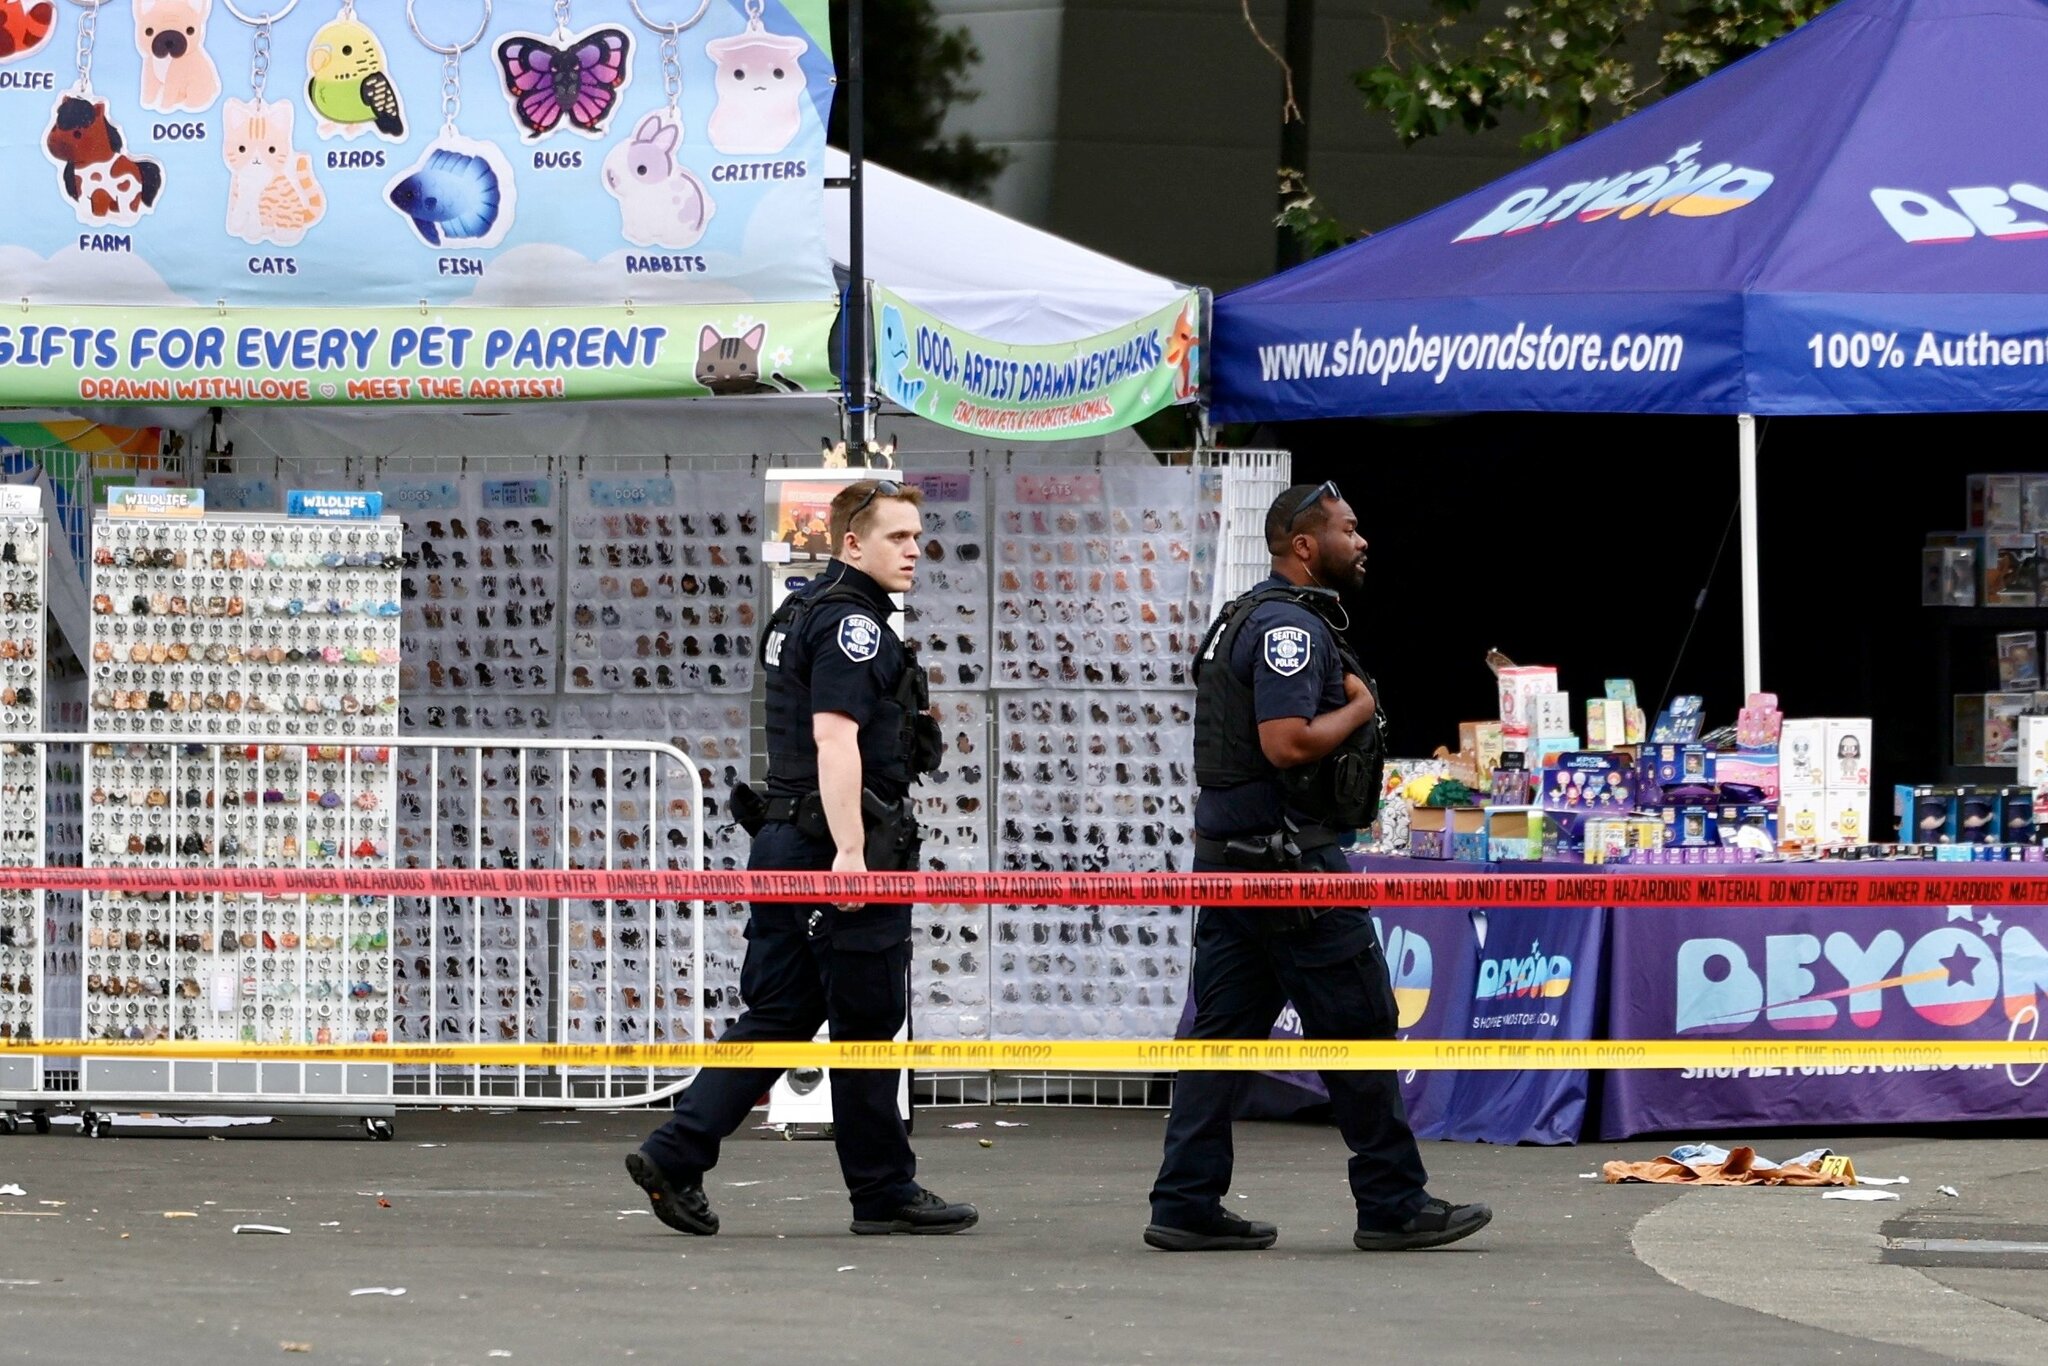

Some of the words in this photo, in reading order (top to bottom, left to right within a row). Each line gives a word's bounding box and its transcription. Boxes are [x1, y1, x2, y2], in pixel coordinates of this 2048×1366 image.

[153, 123, 206, 140] DOGS
[327, 151, 386, 168] BIRDS
[533, 151, 582, 168] BUGS
[712, 161, 807, 182] CRITTERS
[1450, 160, 1774, 244] BEYOND
[79, 234, 131, 252] FARM
[248, 257, 298, 274] CATS
[438, 257, 483, 275] FISH
[626, 256, 706, 274] RABBITS
[130, 326, 225, 369] FOR
[236, 327, 379, 369] EVERY
[391, 326, 472, 368] PET
[485, 327, 666, 368] PARENT
[1259, 322, 1683, 386] www.shopbeyondstore.com
[1808, 332, 1905, 368] 100%
[916, 325, 959, 383] 1000+
[962, 349, 1018, 401] ARTIST
[1019, 362, 1077, 402] DRAWN
[1079, 328, 1162, 394] KEYCHAINS
[81, 379, 171, 401] DRAWN
[175, 379, 246, 400] WITH
[248, 379, 309, 400] LOVE
[347, 378, 411, 400] MEET
[418, 378, 465, 398] THE
[468, 377, 565, 399] ARTIST!
[953, 401, 975, 424] FIND
[976, 406, 999, 429] YOUR
[998, 409, 1018, 430] PETS
[1025, 406, 1071, 430] FAVORITE
[1070, 397, 1113, 423] ANIMALS
[399, 490, 431, 501] DOGS
[615, 488, 646, 499] DOGS
[1041, 483, 1072, 496] CATS
[125, 493, 187, 506] WILDLIFE
[303, 496, 366, 508] WILDLIFE
[847, 618, 876, 634] SEATTLE
[1272, 631, 1303, 642] SEATTLE
[846, 643, 869, 656] POLICE
[1275, 658, 1299, 668] POLICE
[20, 870, 101, 886] HAZARDOUS
[107, 870, 177, 886] MATERIAL
[183, 872, 200, 888] DO
[203, 872, 228, 888] NOT
[234, 872, 276, 888] ENTER
[286, 872, 338, 889] DANGER
[344, 873, 424, 890] HAZARDOUS
[432, 873, 500, 891] MATERIAL
[505, 873, 521, 892] DO
[525, 874, 550, 892] NOT
[555, 874, 597, 893] ENTER
[607, 874, 659, 894] DANGER
[664, 875, 745, 895] HAZARDOUS
[751, 875, 817, 896] MATERIAL
[823, 875, 841, 896] DO
[844, 875, 869, 896] NOT
[874, 875, 915, 897] ENTER
[926, 876, 977, 898] DANGER
[983, 876, 1062, 898] HAZARDOUS
[1070, 877, 1135, 898] MATERIAL
[1141, 877, 1159, 898] DO
[1162, 877, 1187, 898] NOT
[1191, 878, 1232, 898] ENTER
[1242, 878, 1293, 899] DANGER
[1300, 878, 1378, 900] HAZARDOUS
[1384, 878, 1450, 900] MATERIAL
[1456, 879, 1473, 900] DO
[1477, 879, 1501, 900] NOT
[1506, 879, 1547, 900] ENTER
[1556, 880, 1607, 901] DANGER
[1612, 880, 1690, 901] HAZARDOUS
[1698, 880, 1761, 902] MATERIAL
[1768, 880, 1785, 902] DO
[1789, 880, 1815, 902] NOT
[1818, 881, 1858, 902] ENTER
[1868, 881, 1919, 902] DANGER
[1925, 881, 2002, 902] HAZARDOUS
[1476, 955, 1572, 1000] BEYOND
[1825, 1158, 1843, 1176] 78
